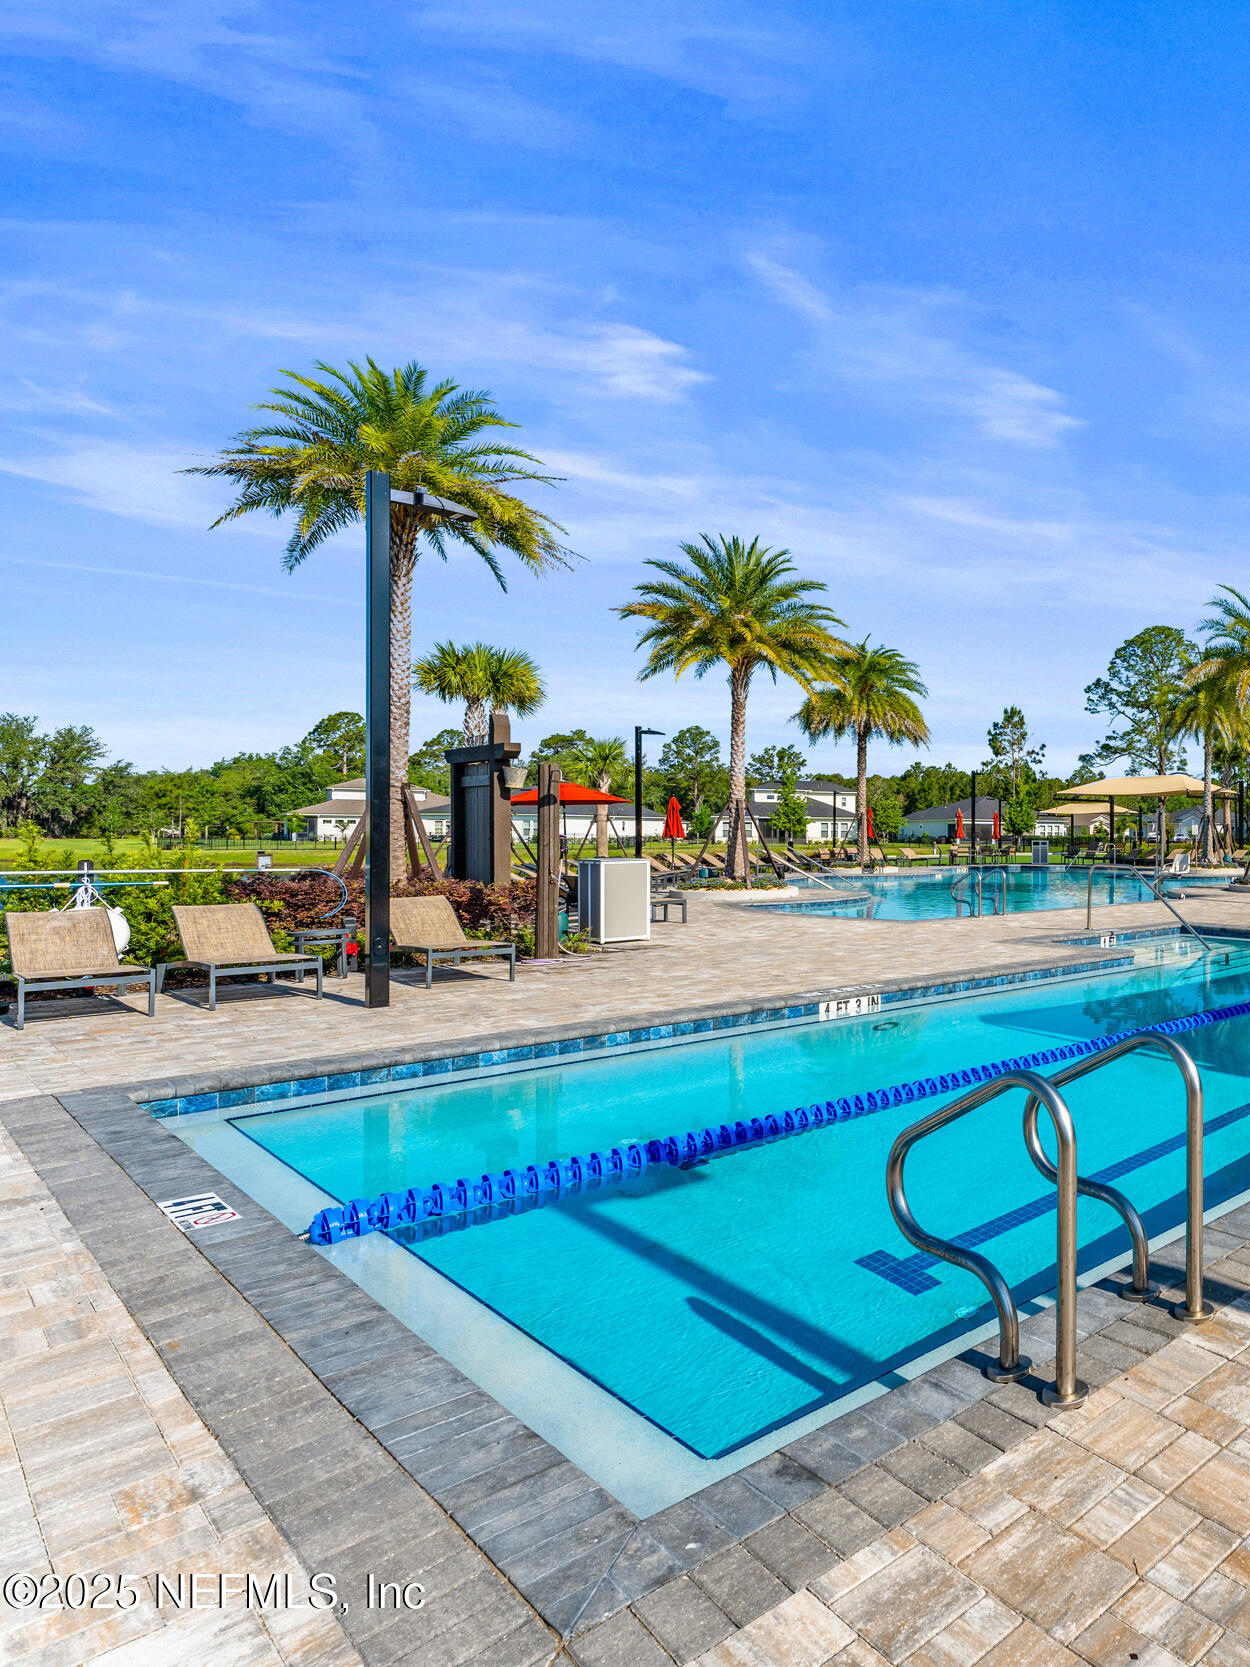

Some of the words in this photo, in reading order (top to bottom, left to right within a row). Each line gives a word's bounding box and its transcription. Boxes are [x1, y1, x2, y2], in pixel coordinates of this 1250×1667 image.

[824, 1002, 830, 1013] 4
[836, 1000, 850, 1011] FT
[855, 998, 861, 1008] 3
[867, 996, 879, 1007] IN
[170, 1201, 228, 1219] FT
